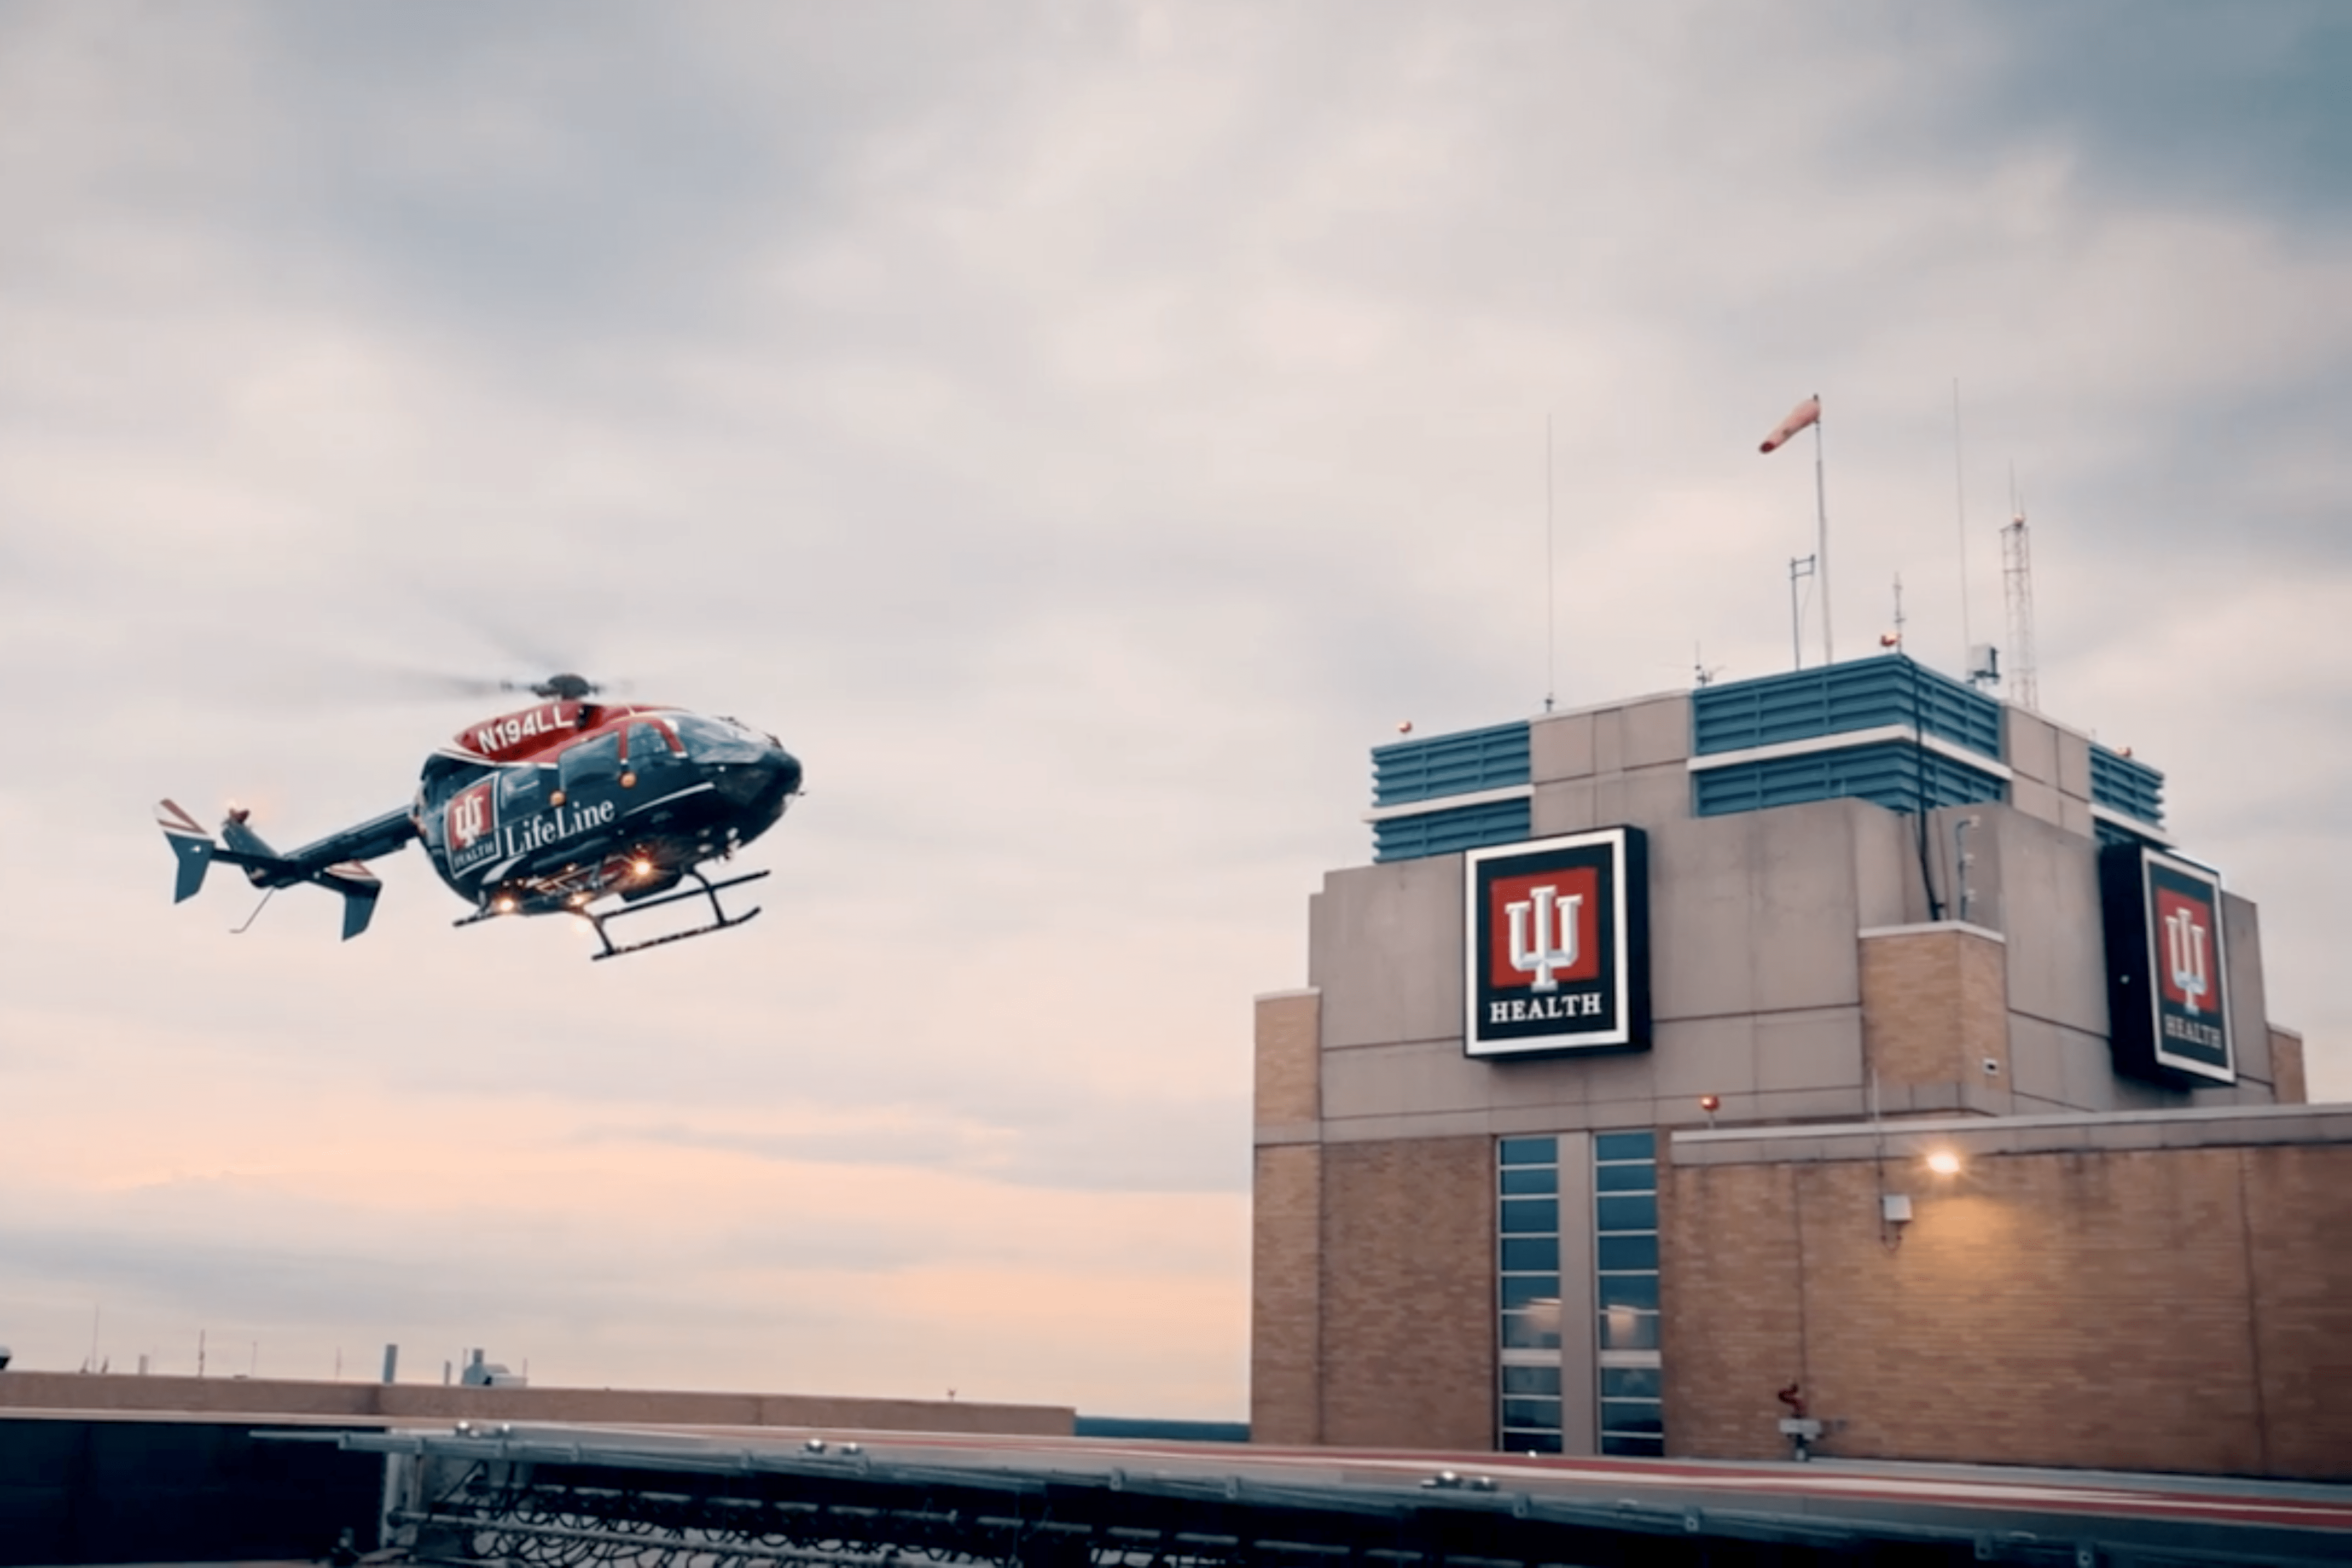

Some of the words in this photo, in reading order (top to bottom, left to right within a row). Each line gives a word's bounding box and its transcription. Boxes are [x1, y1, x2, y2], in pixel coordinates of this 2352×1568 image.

[478, 705, 574, 754] N194LL
[505, 800, 615, 857] LifeLine
[1489, 992, 1602, 1024] HEALTH
[2164, 1013, 2222, 1050] HEALTH
